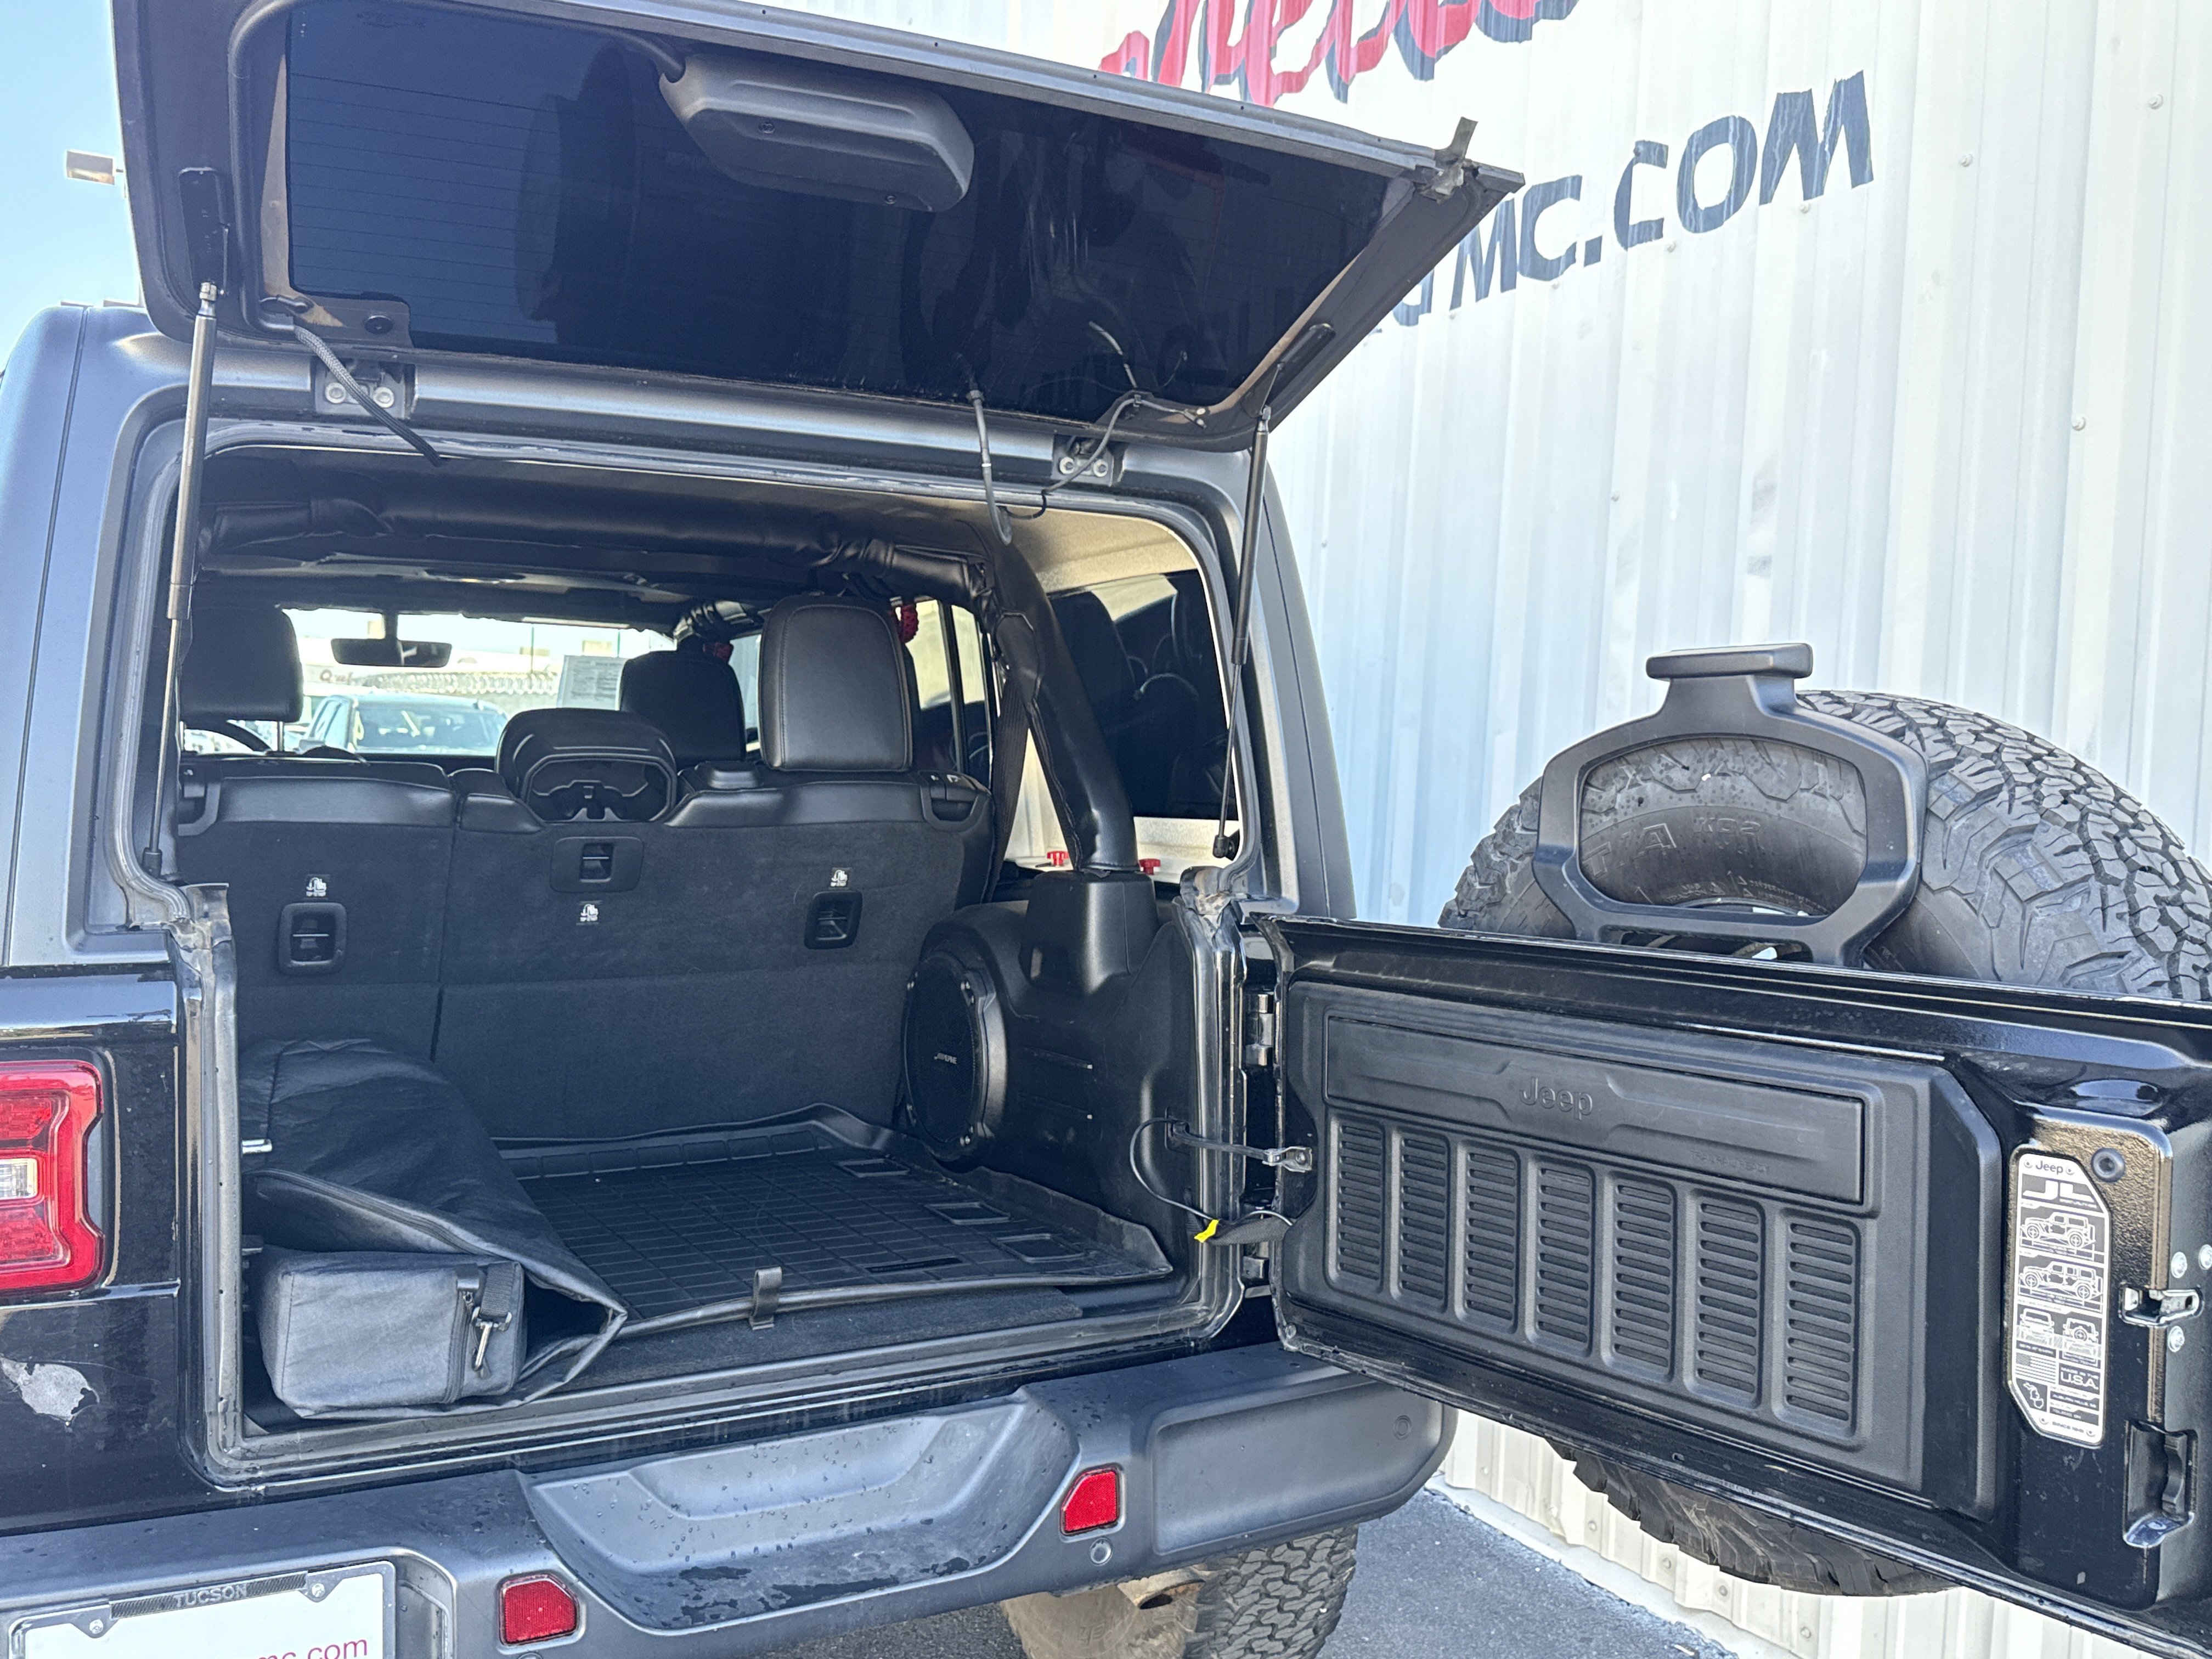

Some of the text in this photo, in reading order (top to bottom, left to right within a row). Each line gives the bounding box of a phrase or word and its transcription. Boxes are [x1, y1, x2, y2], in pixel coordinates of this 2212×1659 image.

[1519, 1076, 1593, 1120] Jeep
[2035, 1160, 2063, 1175] Jeep
[174, 1583, 247, 1608] TUCSON
